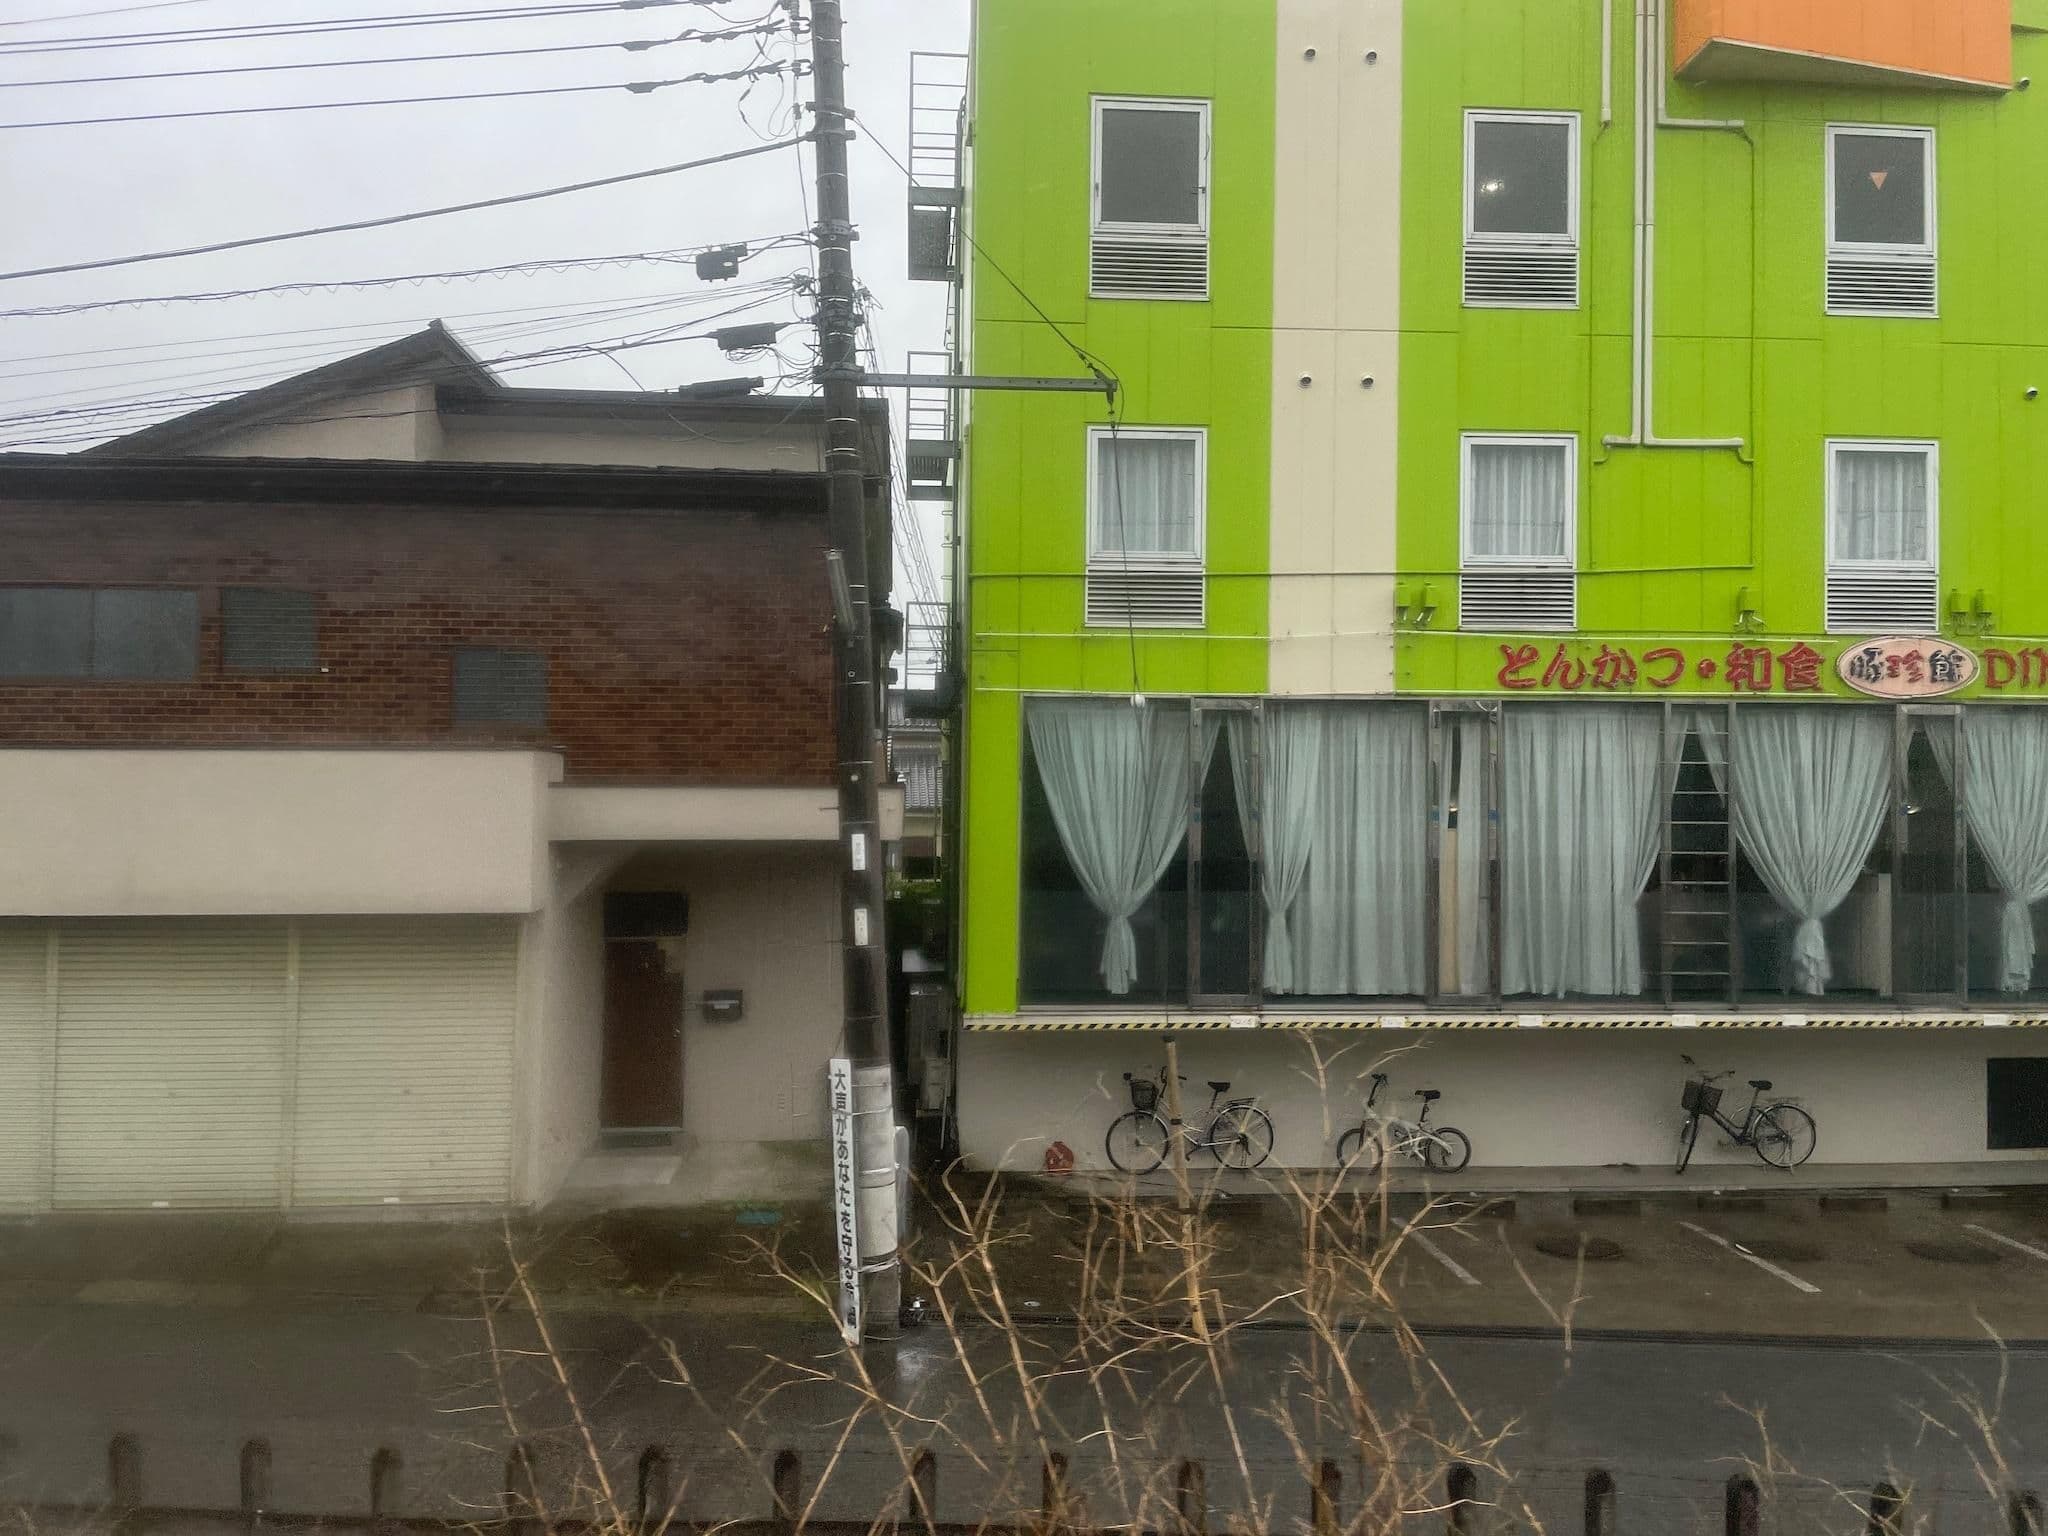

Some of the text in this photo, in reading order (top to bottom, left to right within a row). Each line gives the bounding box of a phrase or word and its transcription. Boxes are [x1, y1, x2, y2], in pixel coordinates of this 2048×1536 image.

[1497, 641, 1825, 691] とんかつ・和食
